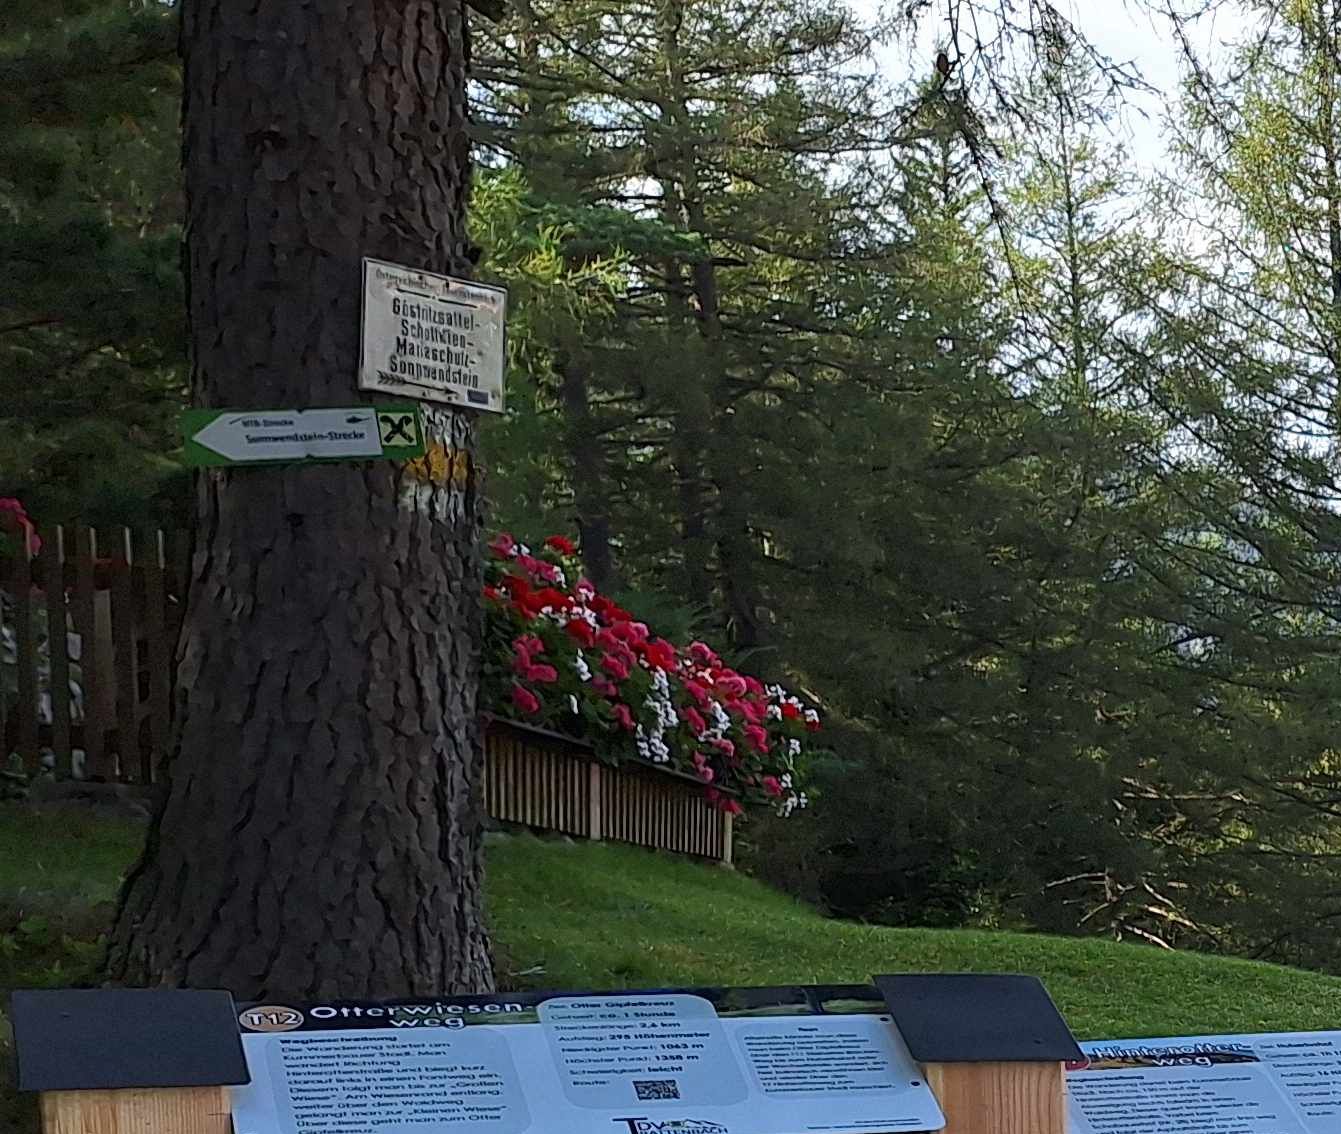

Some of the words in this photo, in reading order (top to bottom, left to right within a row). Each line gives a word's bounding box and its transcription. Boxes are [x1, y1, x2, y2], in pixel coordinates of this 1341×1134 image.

[311, 1002, 534, 1019] Otterwiesen-
[247, 1013, 298, 1025] T12
[389, 1017, 465, 1029] weg
[306, 1045, 384, 1053] Wanderung
[1152, 1056, 1212, 1066] weg
[294, 1112, 347, 1120] gelangt
